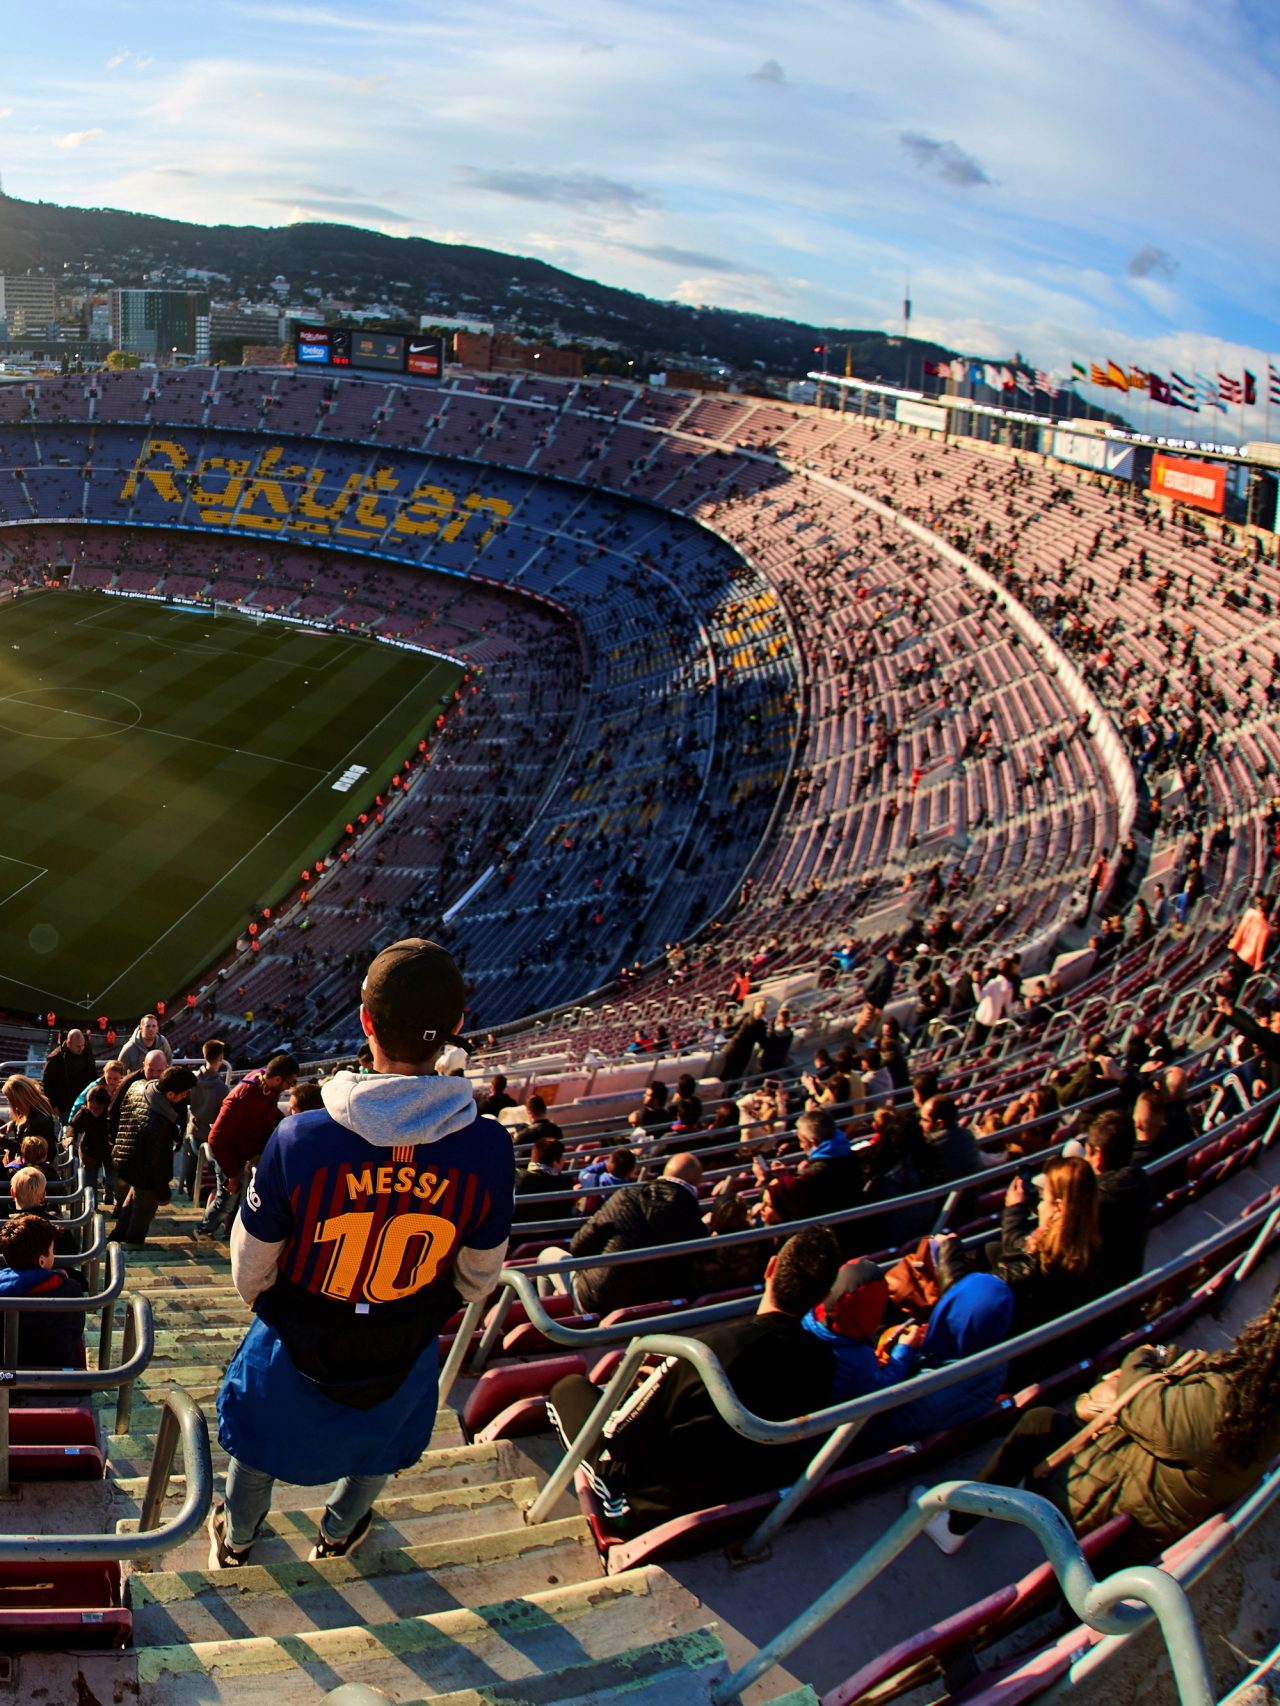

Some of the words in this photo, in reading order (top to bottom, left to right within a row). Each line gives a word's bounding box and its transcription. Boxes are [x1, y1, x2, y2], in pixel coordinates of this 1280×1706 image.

[303, 346, 325, 355] beko
[120, 440, 513, 550] Rakuten
[346, 1166, 450, 1206] MESSI
[313, 1211, 457, 1304] 10
